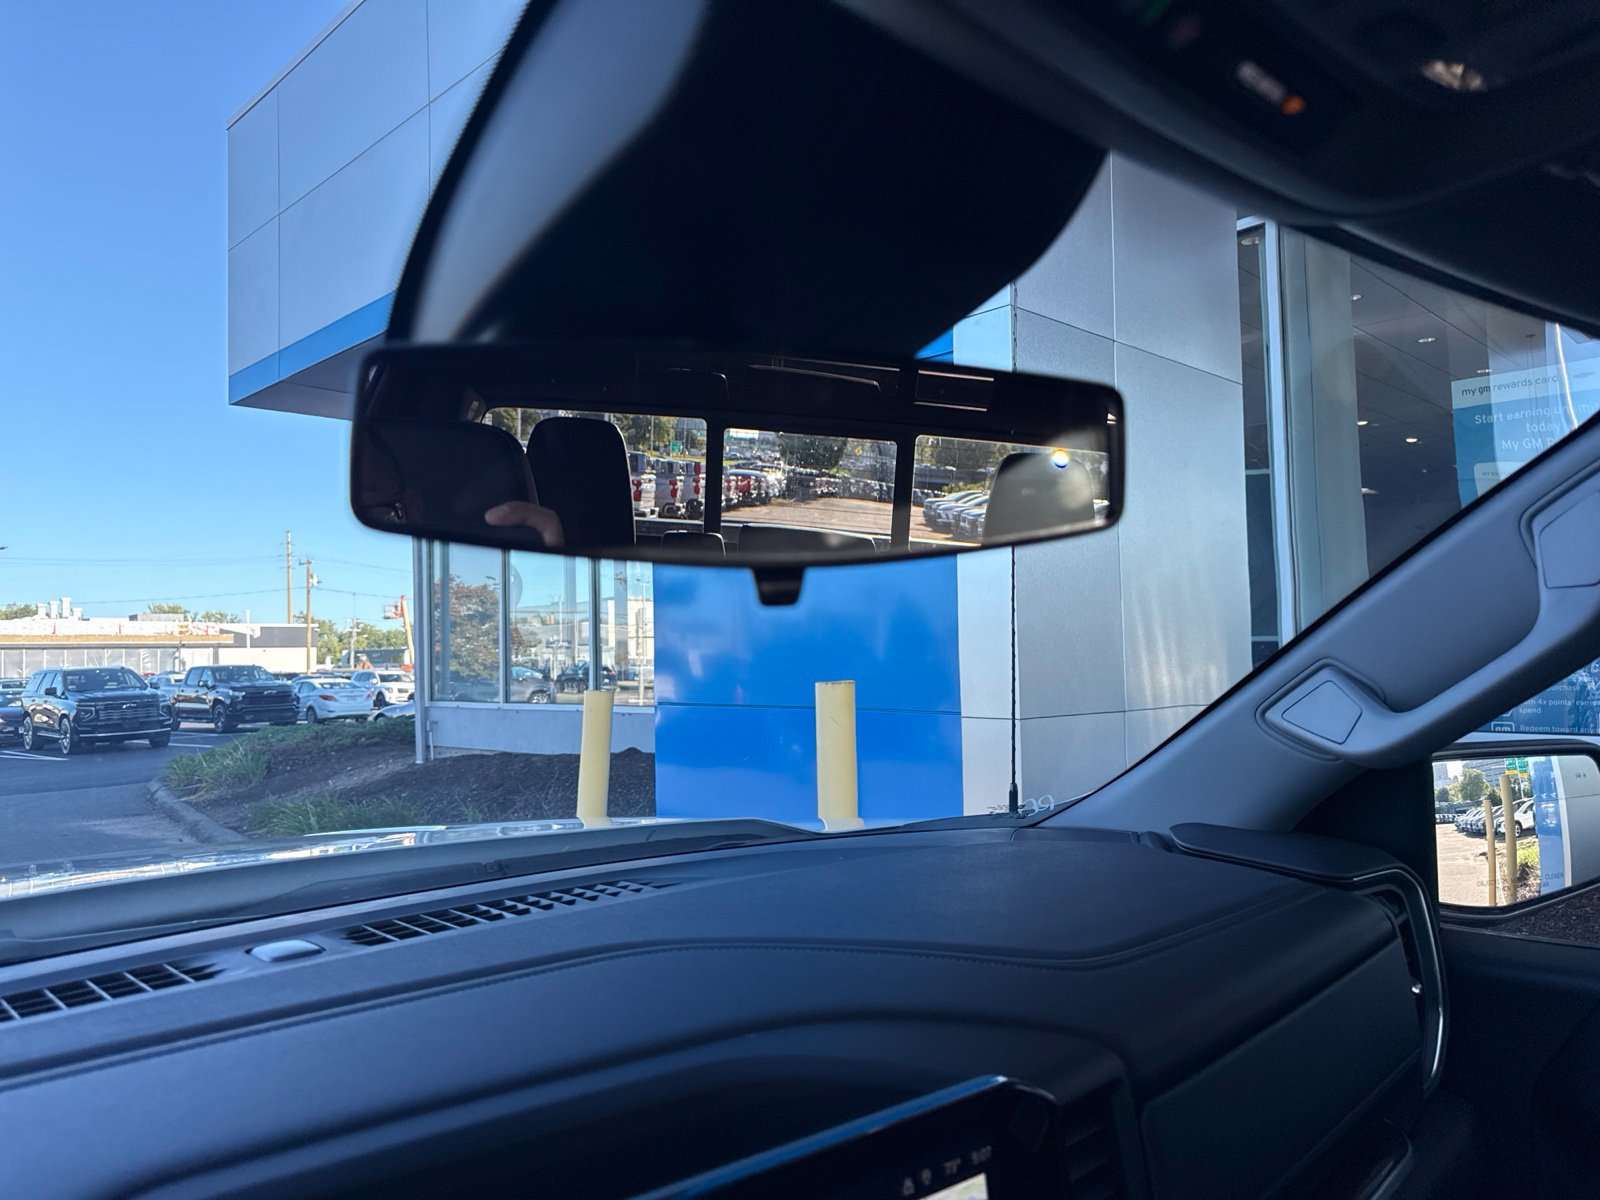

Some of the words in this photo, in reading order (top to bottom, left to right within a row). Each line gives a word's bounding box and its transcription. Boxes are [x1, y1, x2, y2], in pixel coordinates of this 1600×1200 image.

[1461, 388, 1476, 397] my
[1478, 386, 1491, 396] gm
[1493, 376, 1533, 391] rewards
[1475, 412, 1503, 425] Start
[1506, 406, 1550, 420] earning
[1526, 421, 1561, 433] today
[1502, 439, 1519, 451] My
[1523, 438, 1543, 449] GM
